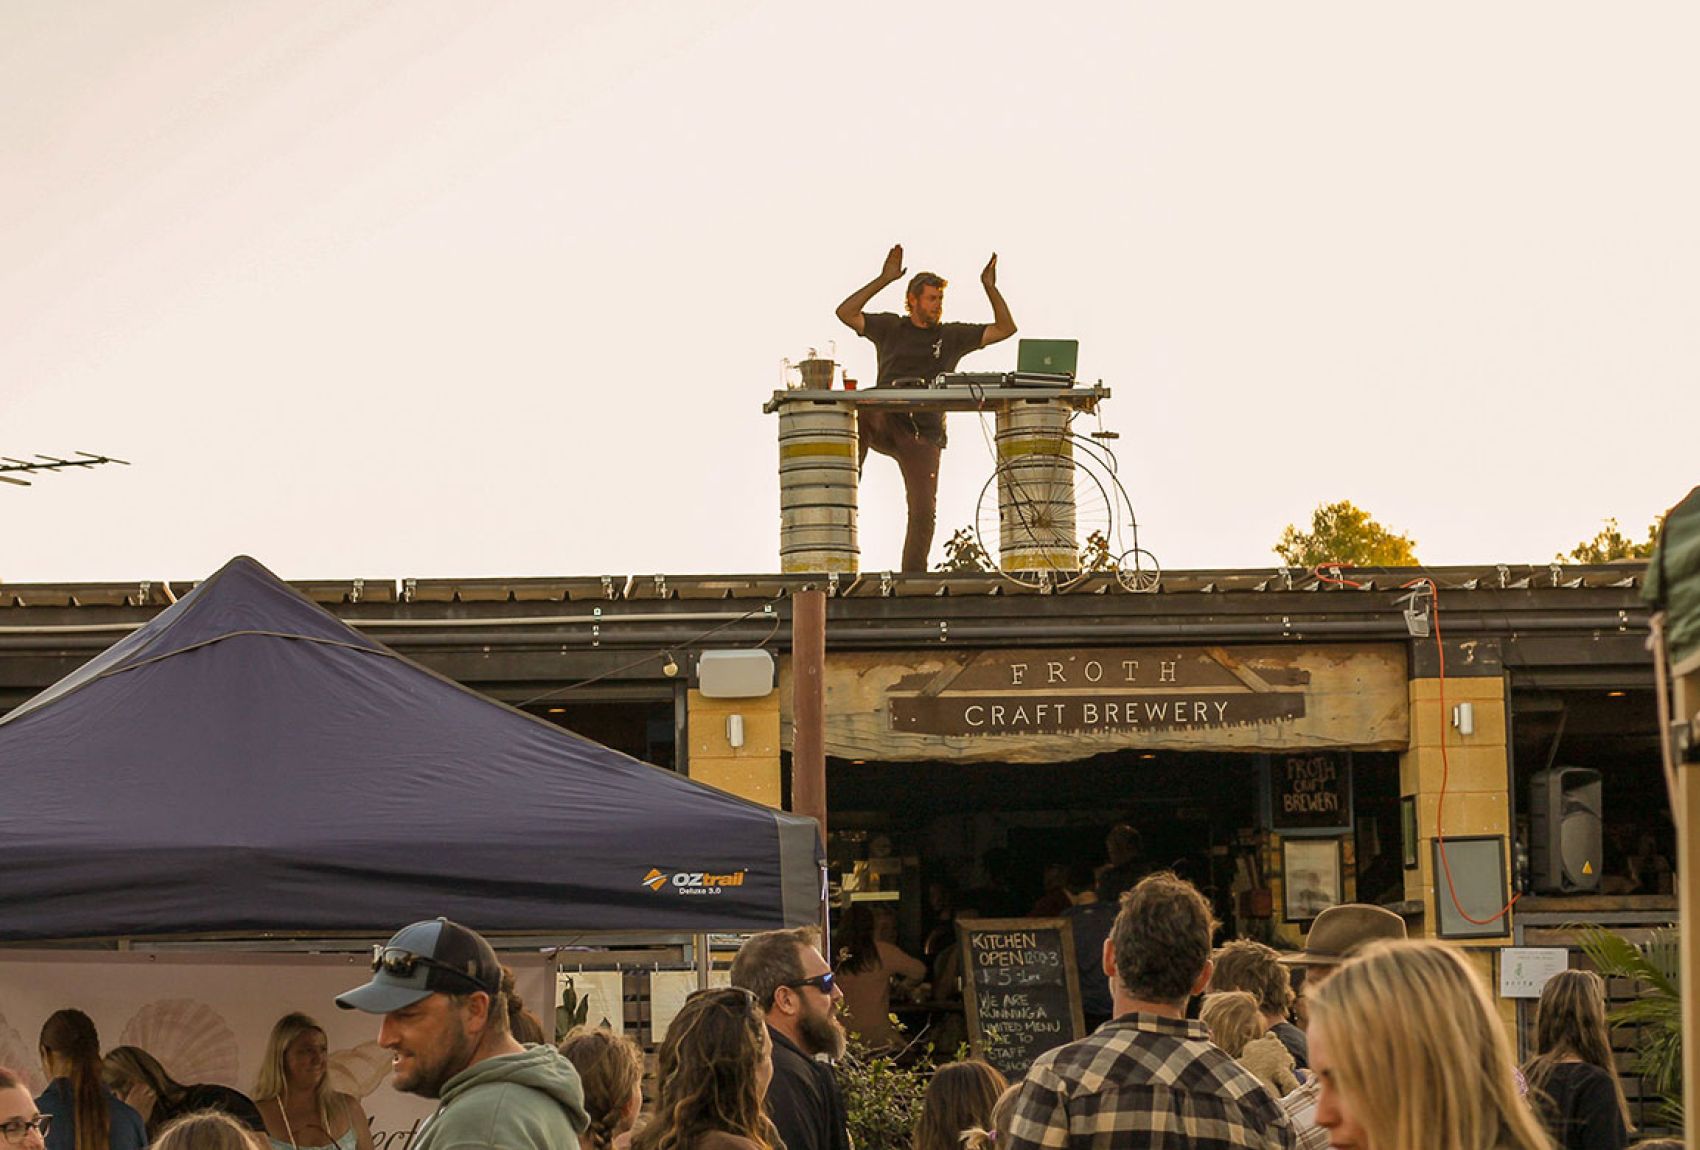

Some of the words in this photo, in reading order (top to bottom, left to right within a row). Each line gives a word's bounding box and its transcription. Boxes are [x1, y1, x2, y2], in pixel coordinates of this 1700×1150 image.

[1011, 660, 1178, 686] FROTH
[964, 704, 1067, 727] CRAFT
[1083, 701, 1230, 725] BREWERY
[972, 933, 1037, 949] KITCHEN
[979, 950, 1024, 967] OPEN
[978, 991, 999, 1008] WE
[1003, 993, 1029, 1008] ARE
[1016, 1033, 1034, 1045] TO
